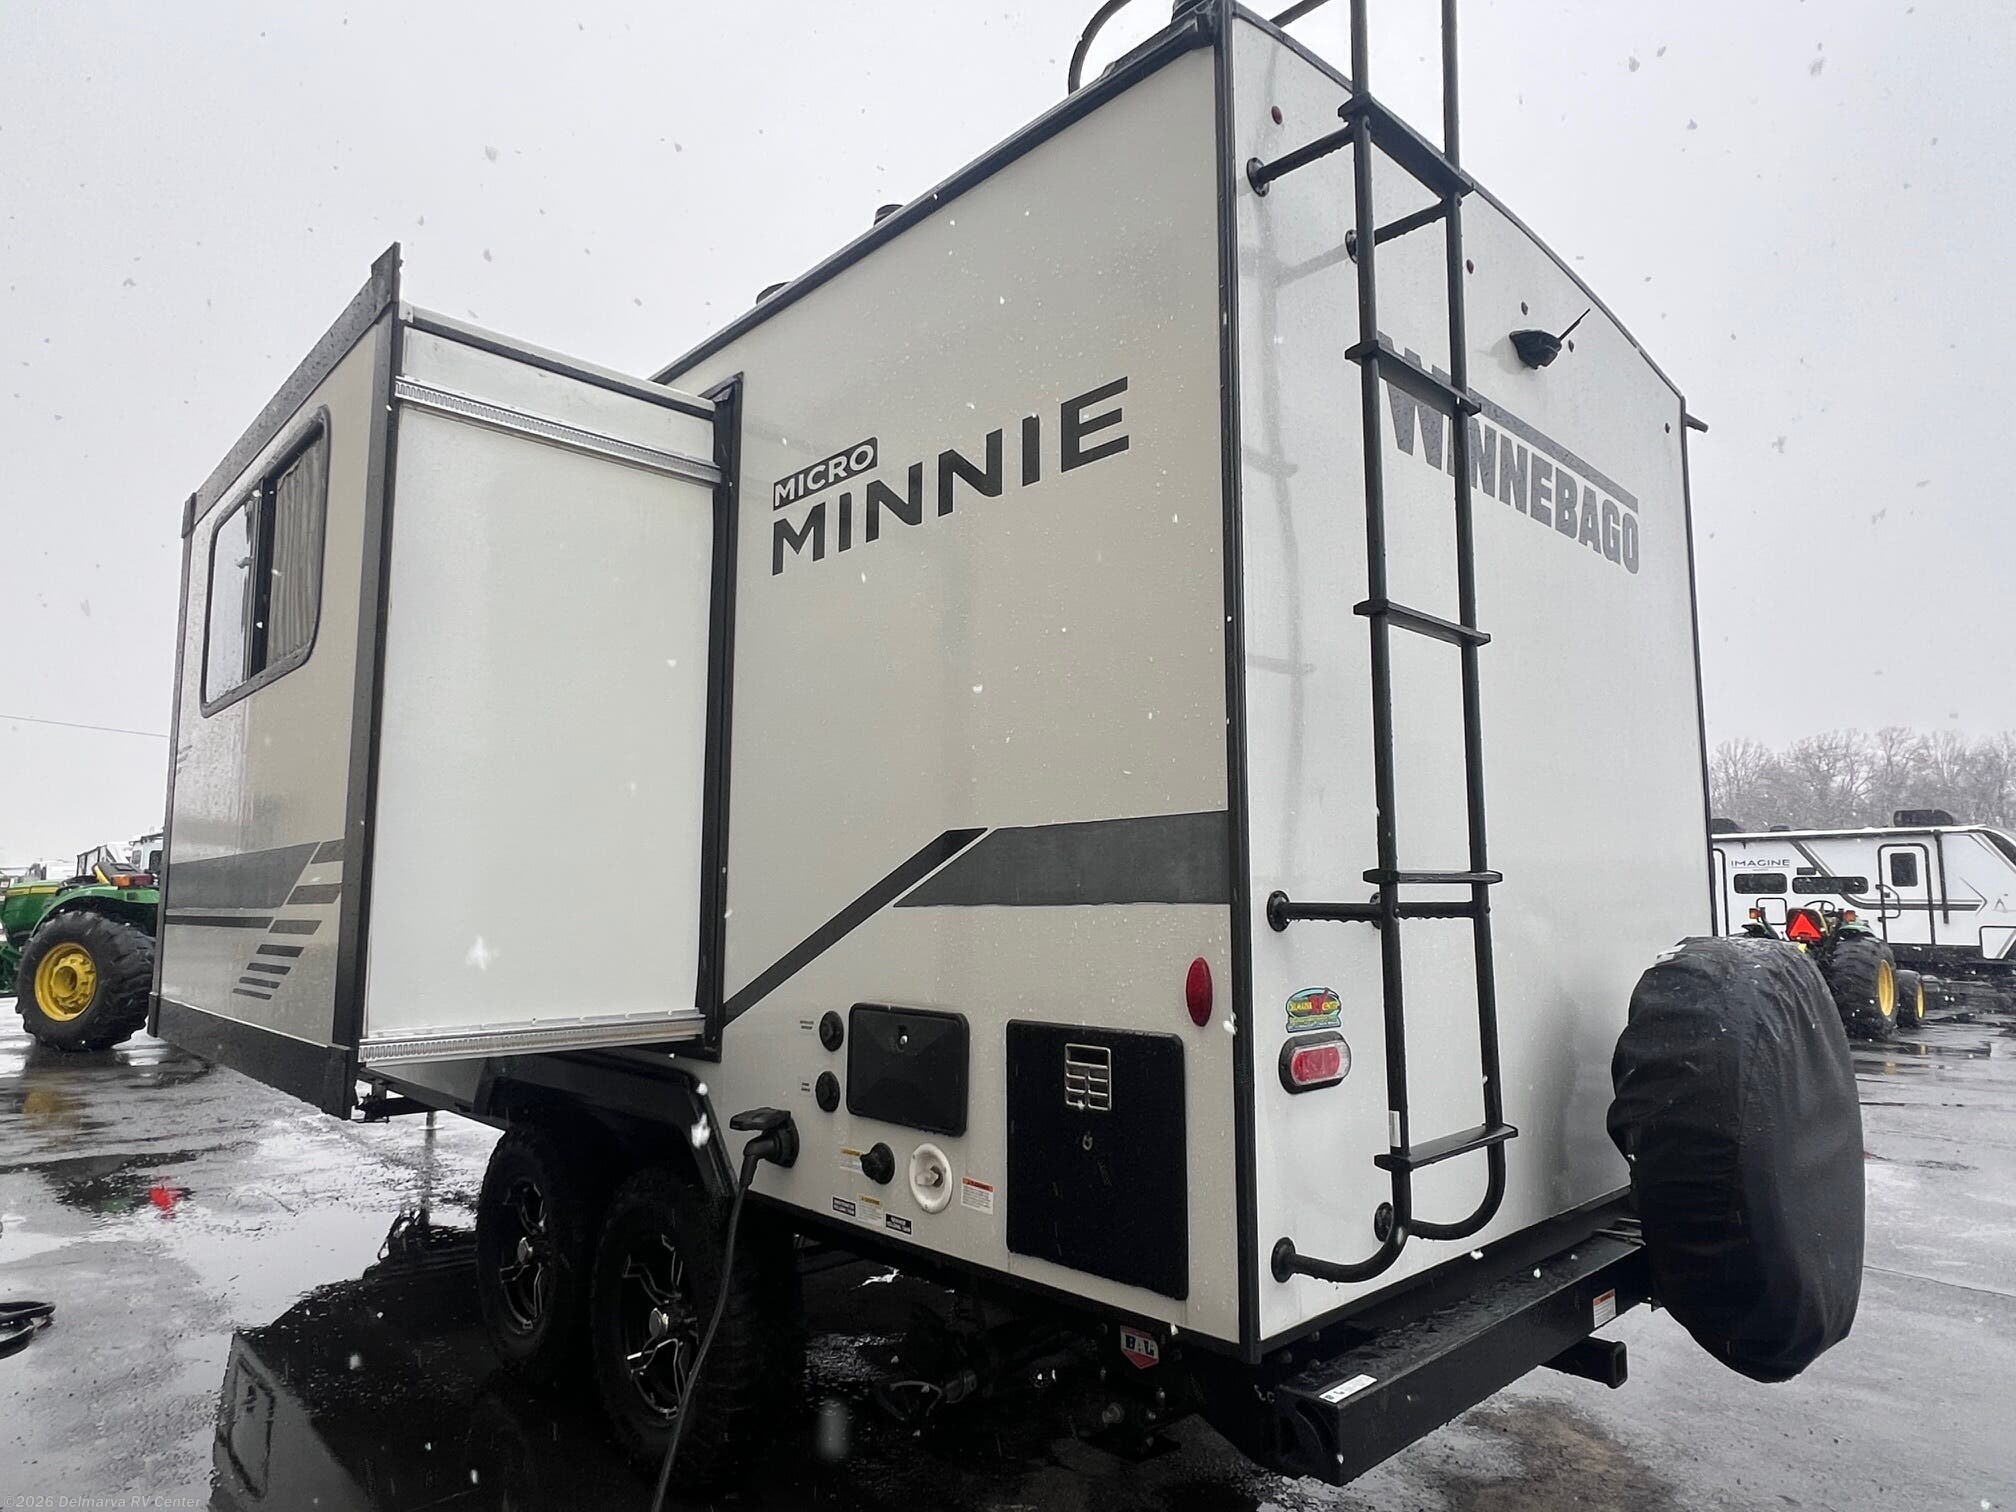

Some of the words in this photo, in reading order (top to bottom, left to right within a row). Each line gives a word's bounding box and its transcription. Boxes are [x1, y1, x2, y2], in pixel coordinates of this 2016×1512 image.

[772, 376, 1130, 577] MINNIE
[774, 443, 875, 507] MICRO
[1731, 859, 1791, 867] IMAGINE
